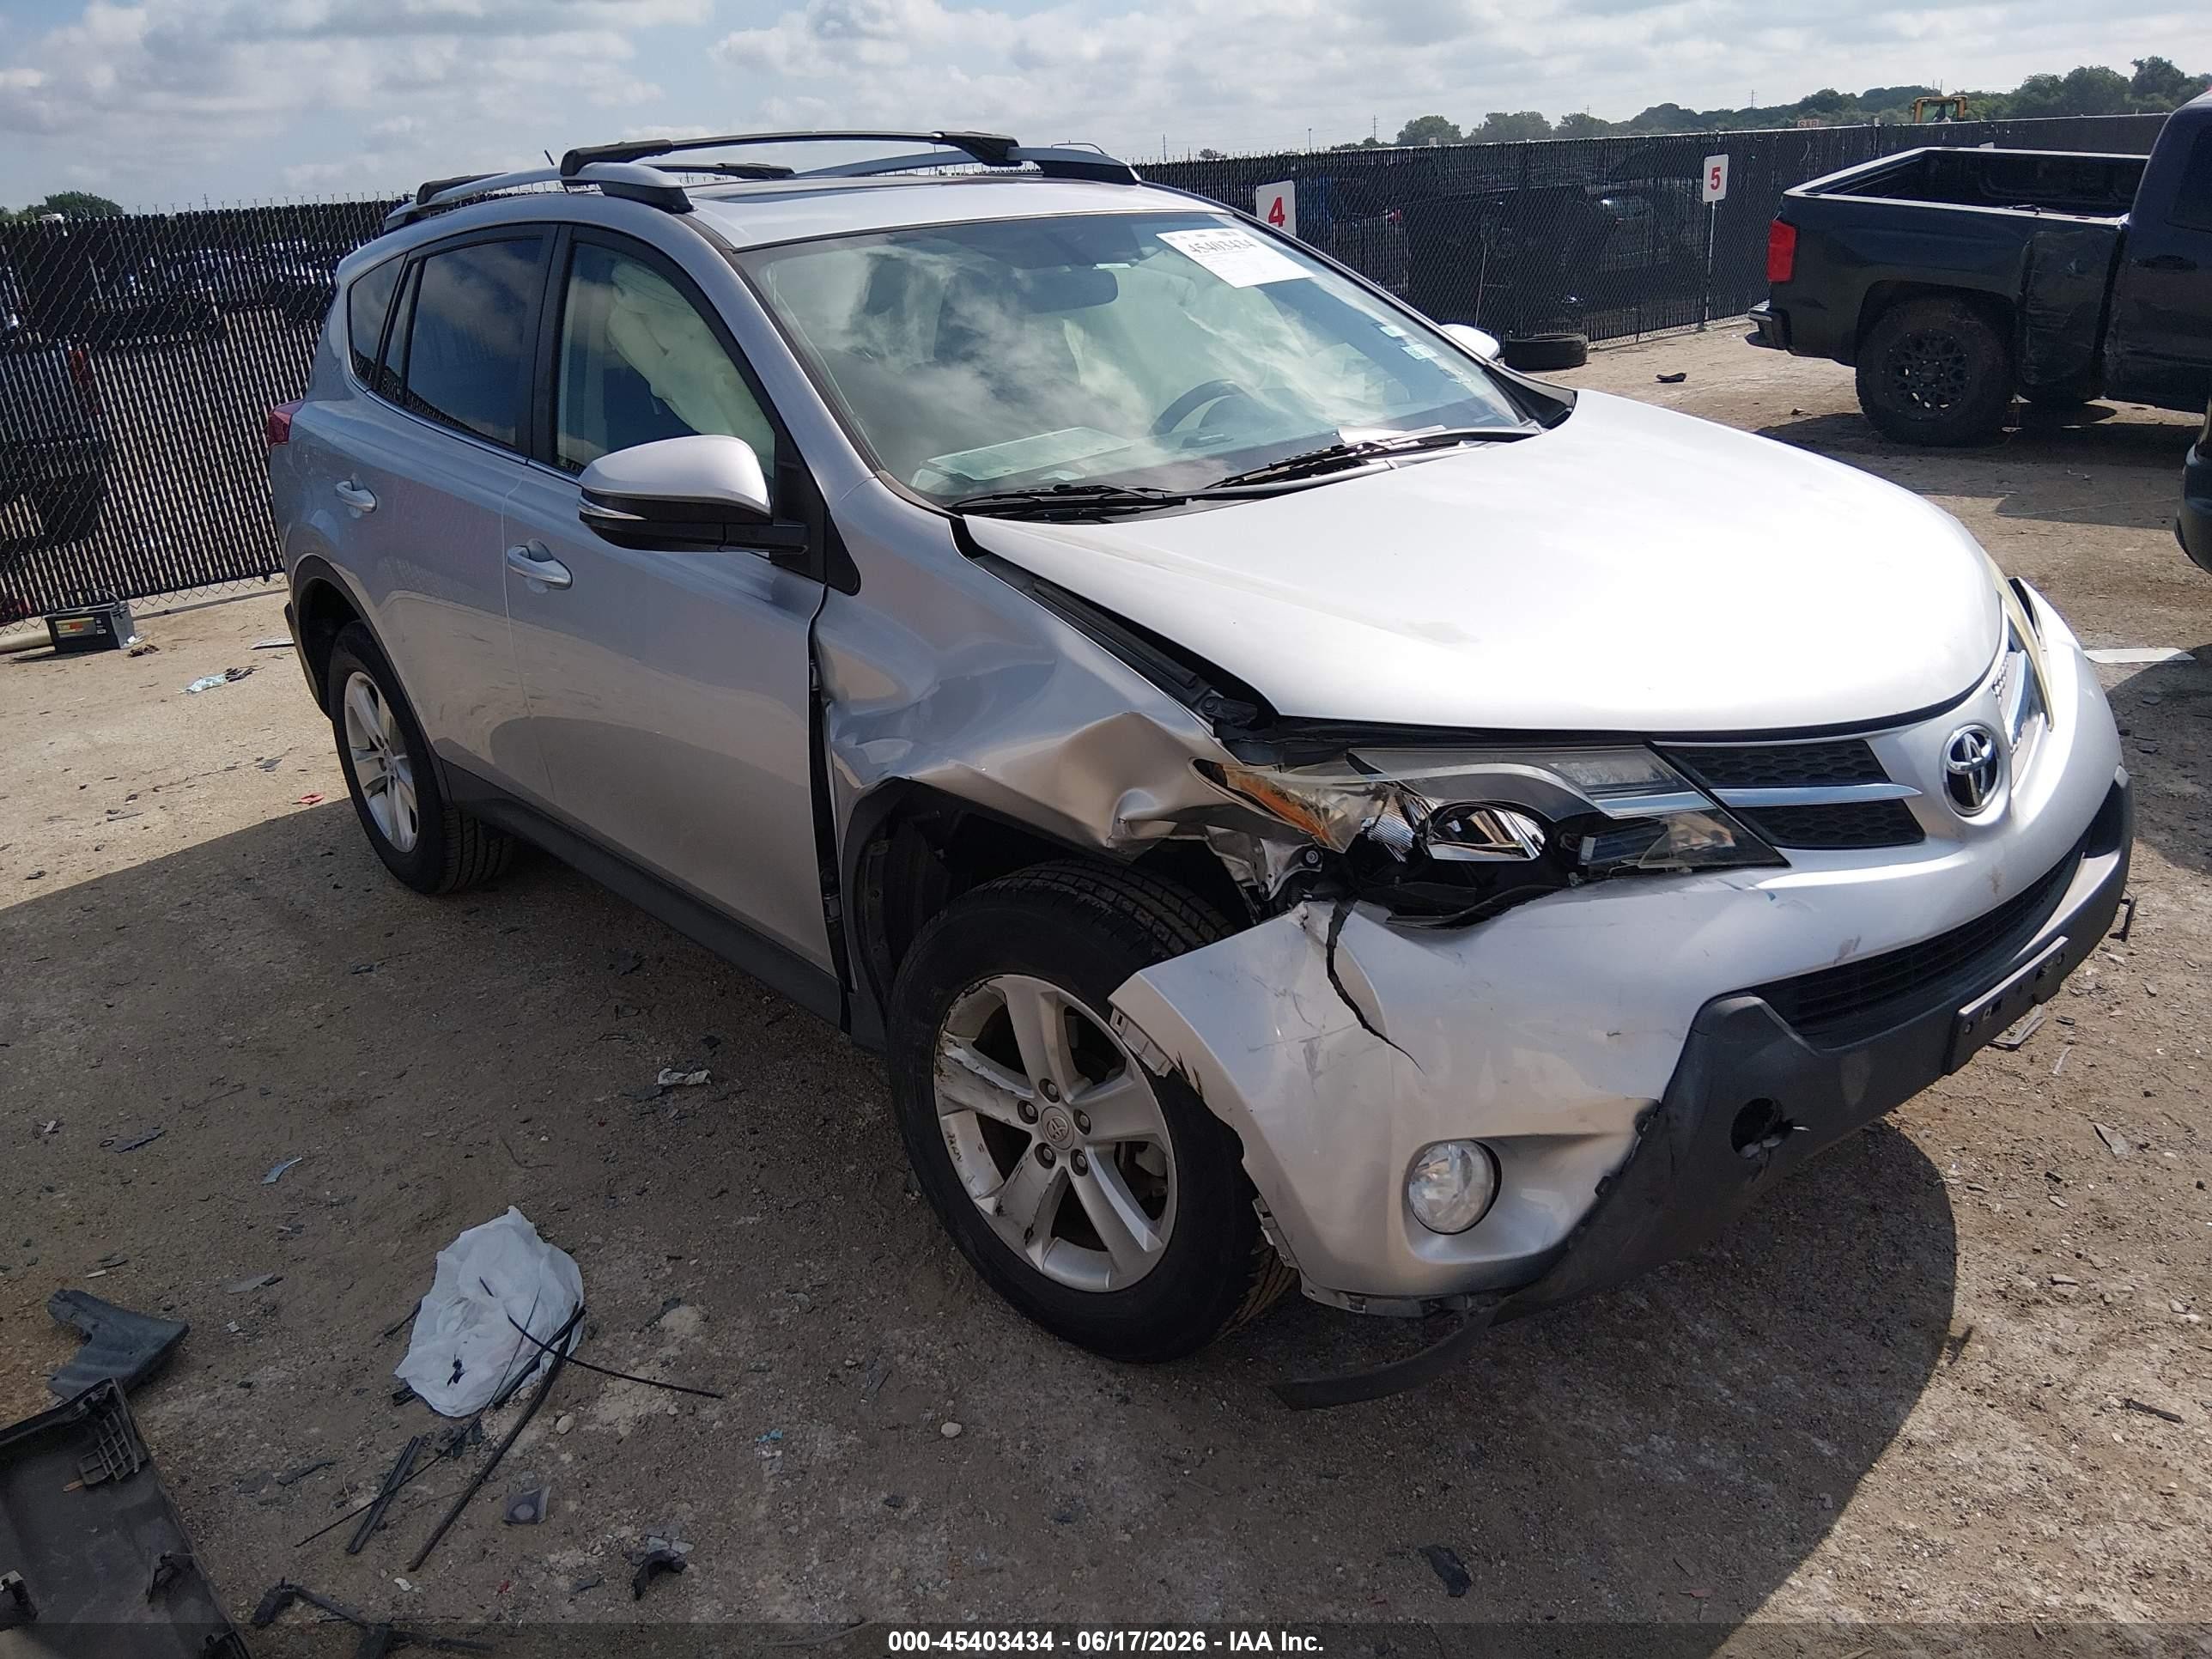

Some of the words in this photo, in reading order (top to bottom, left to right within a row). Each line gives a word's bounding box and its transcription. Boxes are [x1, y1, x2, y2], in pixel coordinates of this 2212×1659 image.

[1710, 166, 1721, 191] 5
[1268, 197, 1285, 228] 4
[1188, 239, 1258, 254] 45403434
